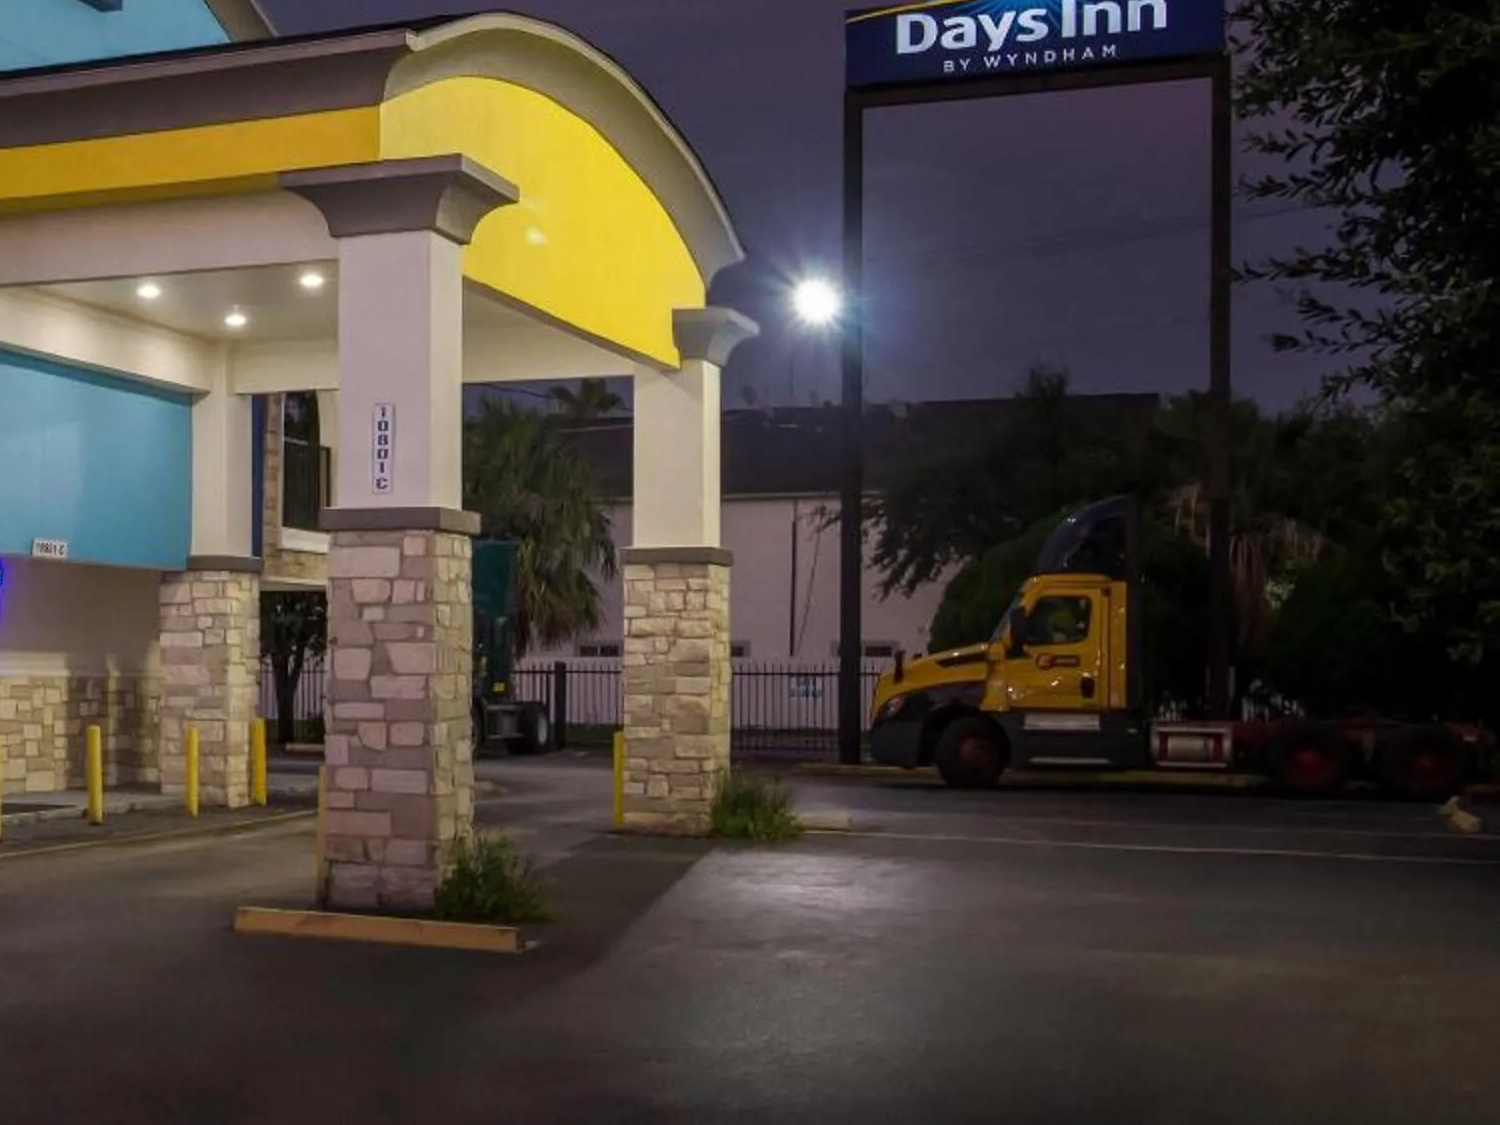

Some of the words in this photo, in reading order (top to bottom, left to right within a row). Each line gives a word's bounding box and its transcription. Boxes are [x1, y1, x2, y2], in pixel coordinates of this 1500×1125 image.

[896, 8, 1048, 54] Days
[943, 56, 972, 73] BY
[983, 44, 1117, 69] WYNDHAM
